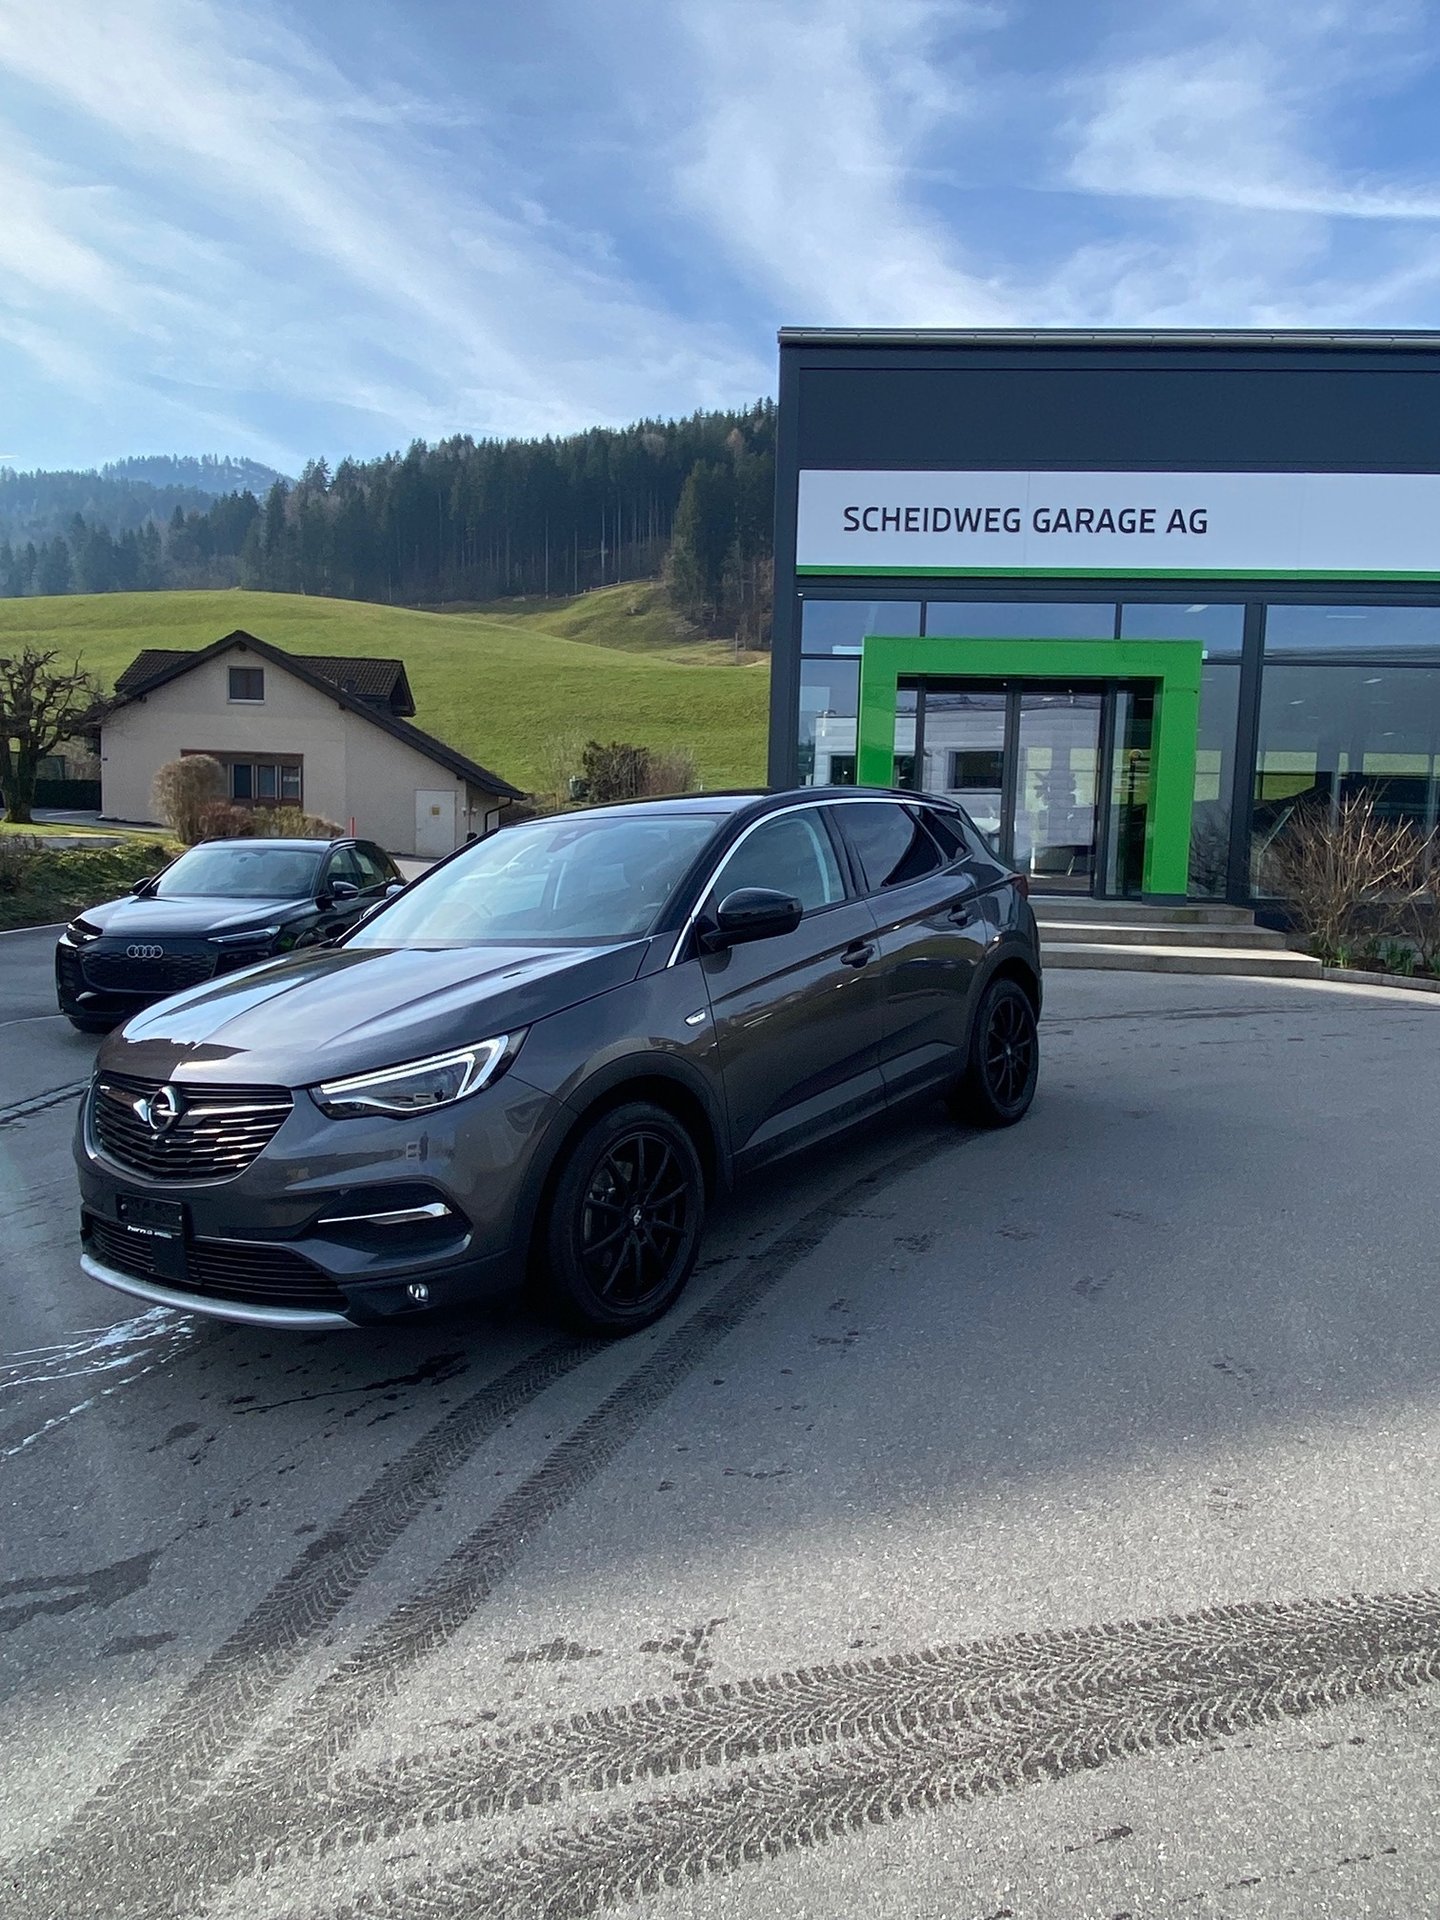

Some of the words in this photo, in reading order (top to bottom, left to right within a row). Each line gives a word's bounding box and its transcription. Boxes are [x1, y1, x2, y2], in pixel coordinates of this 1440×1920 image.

[843, 506, 1021, 533] SCHEIDWEG
[1032, 507, 1157, 534] GARAGE
[1165, 508, 1208, 535] AG
